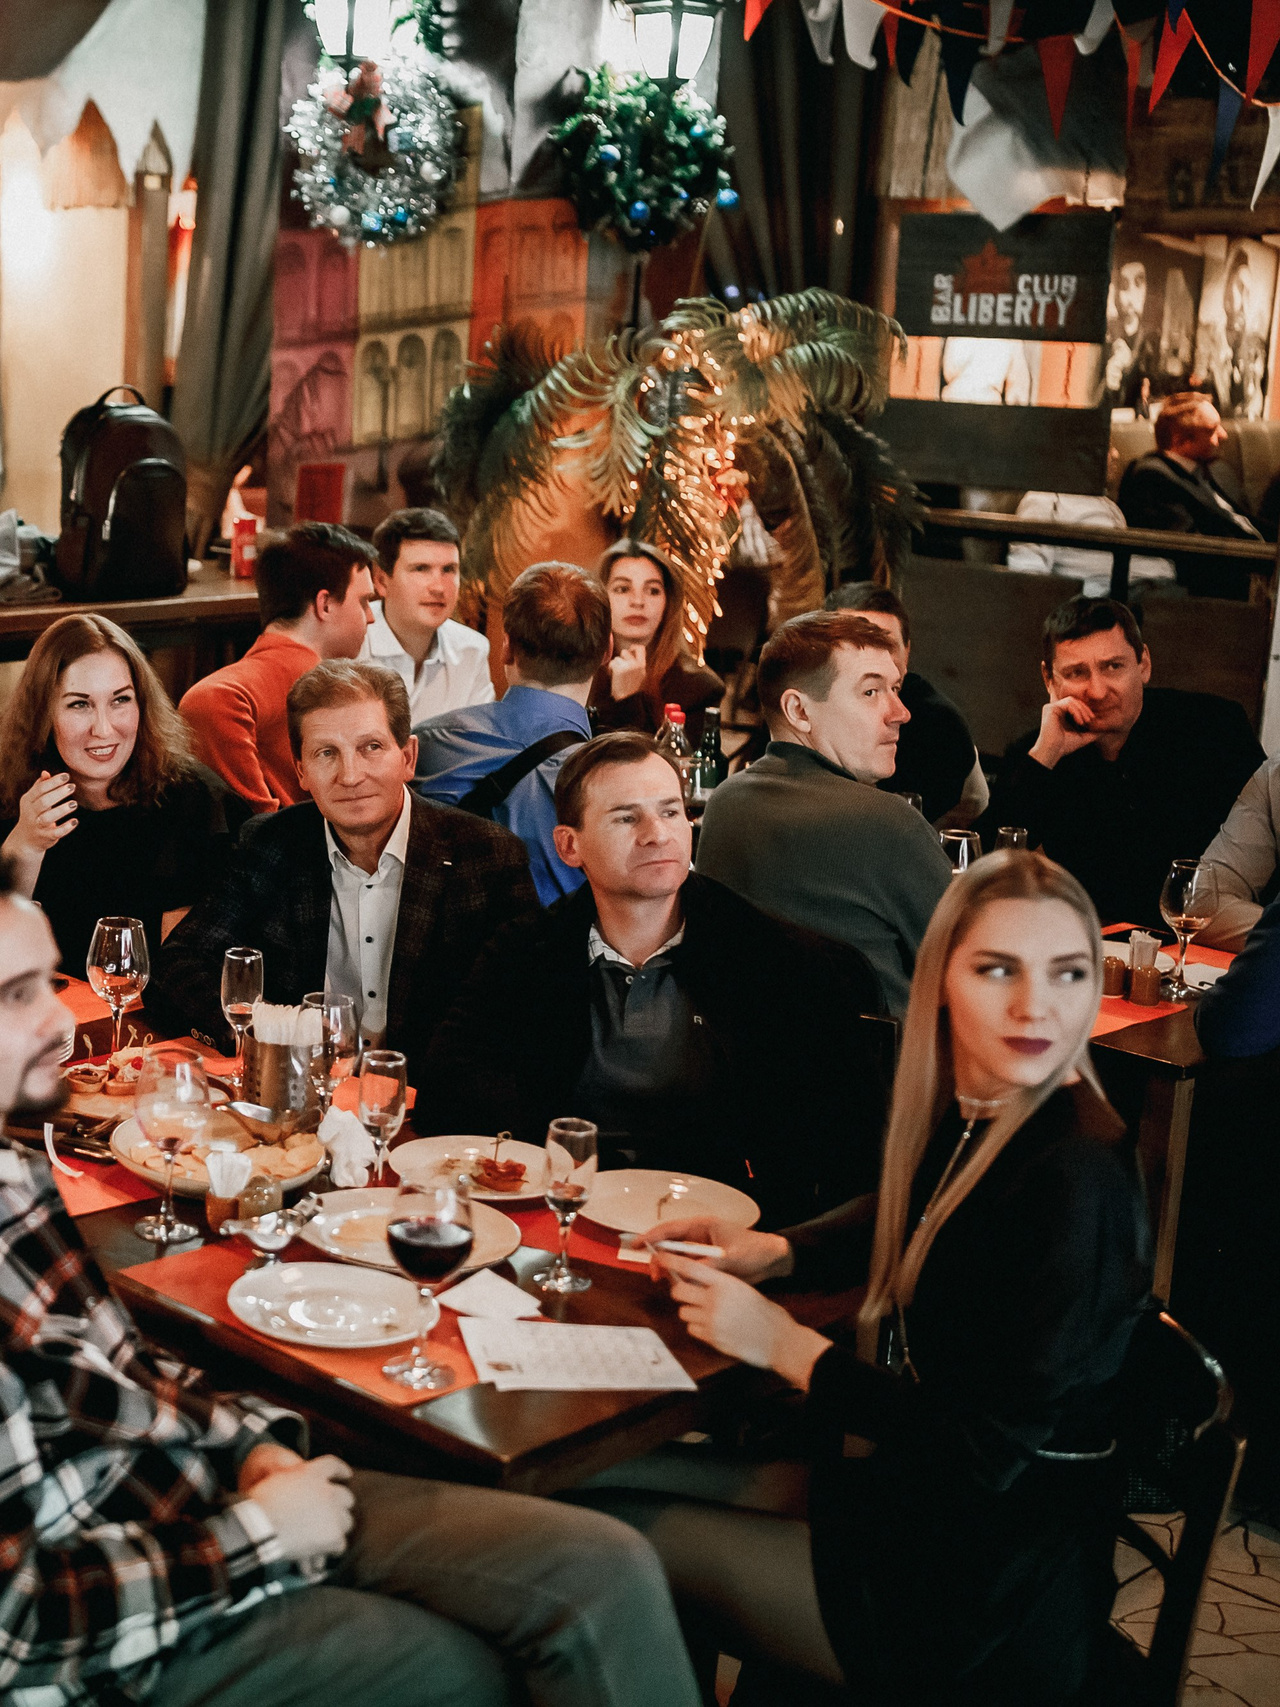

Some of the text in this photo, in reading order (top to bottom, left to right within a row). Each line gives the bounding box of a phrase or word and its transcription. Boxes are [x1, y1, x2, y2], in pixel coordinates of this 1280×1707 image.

[930, 273, 953, 325] BAR
[1017, 273, 1078, 297] CLUB
[952, 293, 1072, 327] LIBERTY
